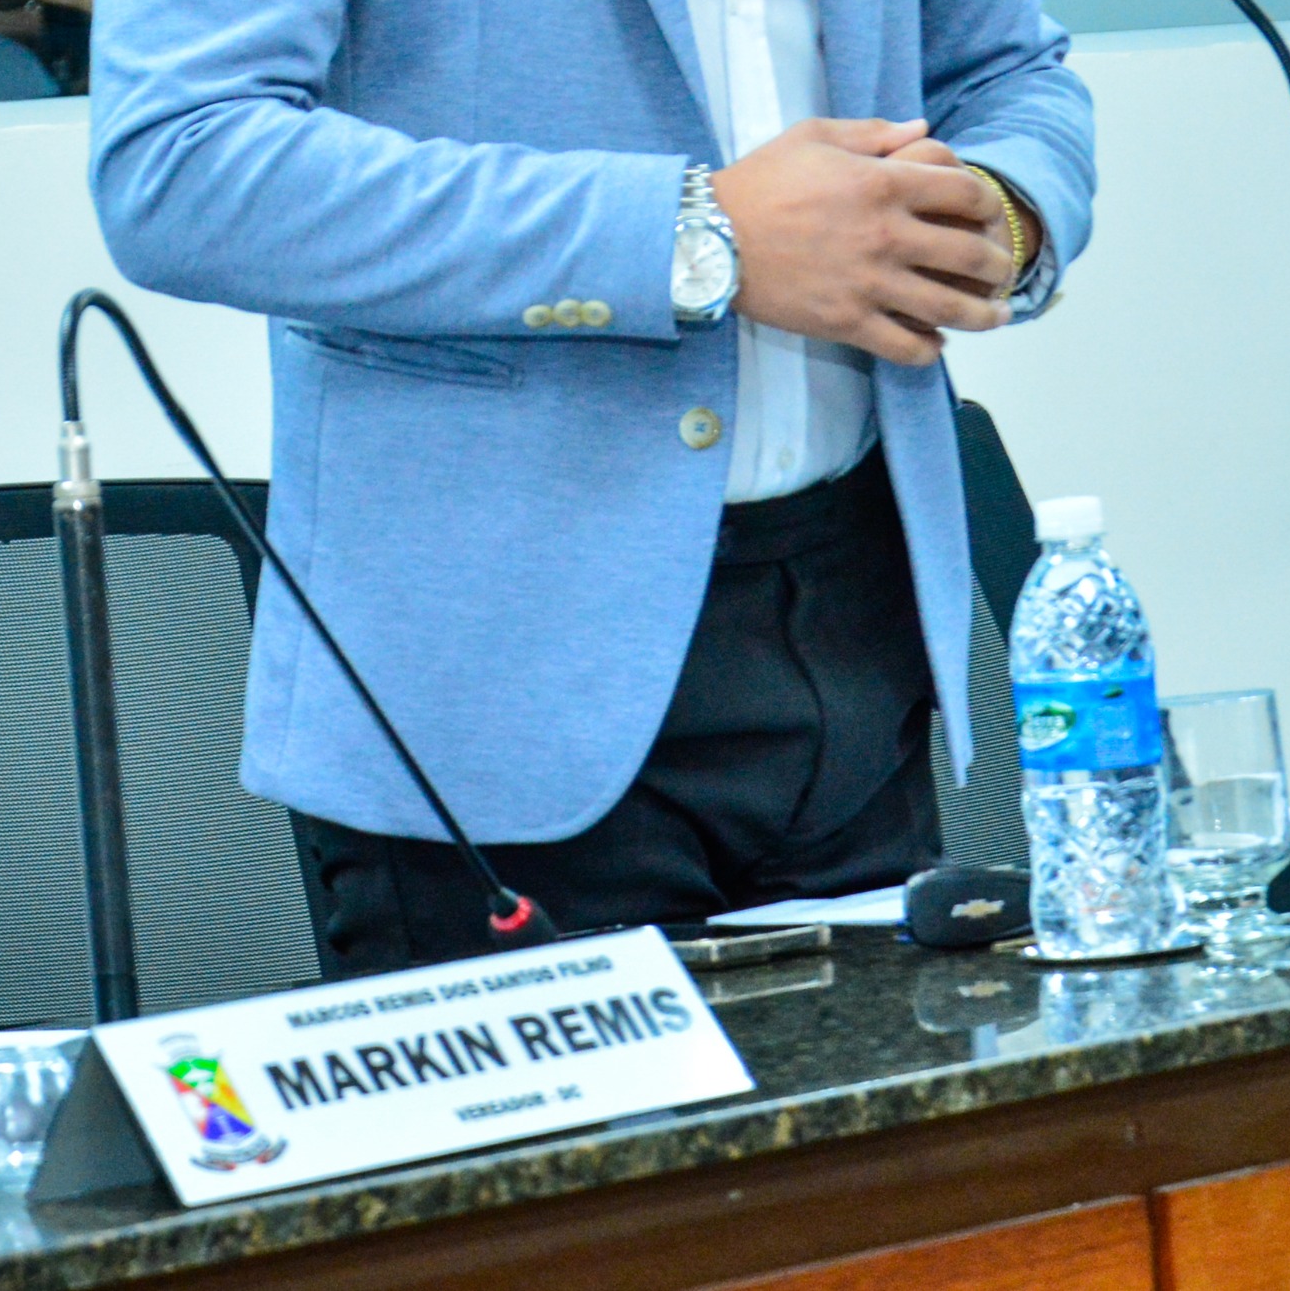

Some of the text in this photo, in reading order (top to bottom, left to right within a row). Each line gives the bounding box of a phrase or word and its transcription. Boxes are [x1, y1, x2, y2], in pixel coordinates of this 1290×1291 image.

[287, 955, 614, 1028] MARCOS REMIS DOS SANTOS FILHO
[264, 986, 694, 1111] MARKIN REMIS
[454, 1090, 547, 1122] VEREADOR
